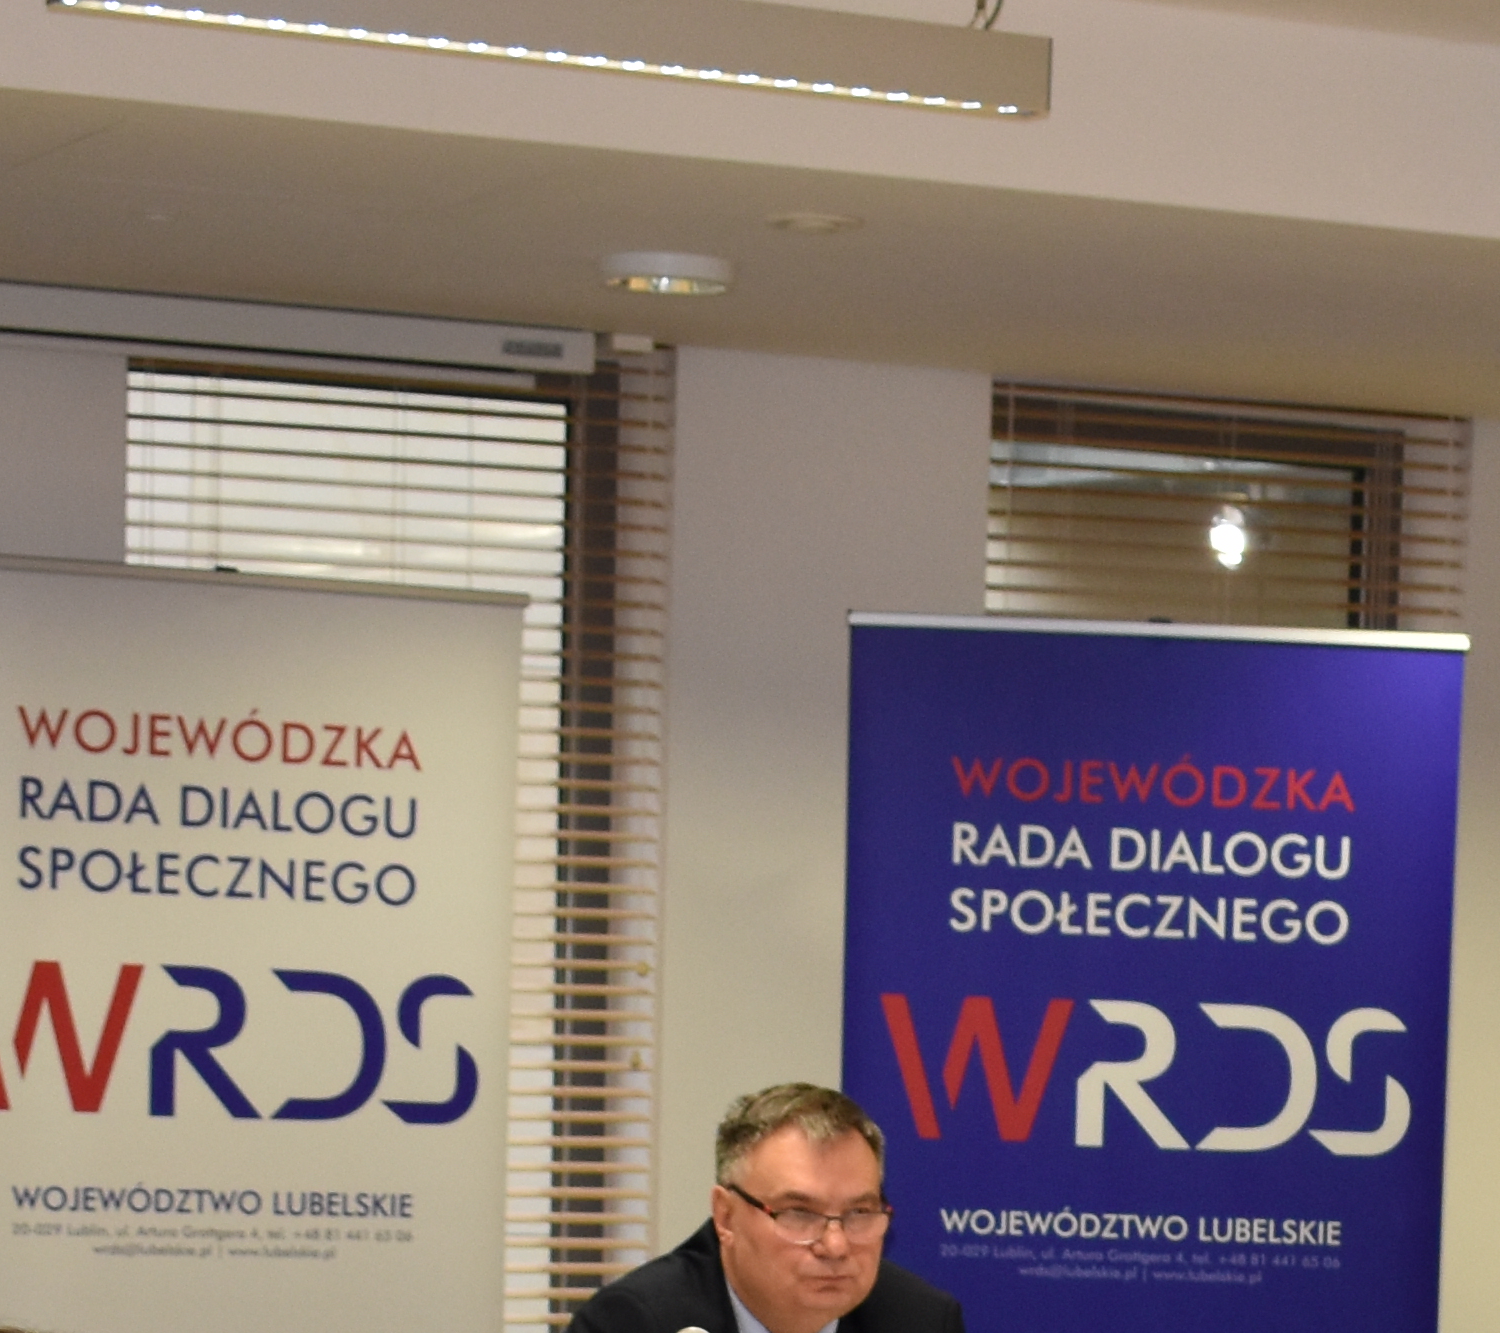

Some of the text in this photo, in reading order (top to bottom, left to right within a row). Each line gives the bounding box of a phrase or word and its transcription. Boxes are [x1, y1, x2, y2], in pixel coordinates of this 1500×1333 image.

[17, 705, 423, 772] WOJEWÓDZKA
[19, 776, 418, 839] RADA DIALOGU
[951, 754, 1355, 812] WOJEWÓDZKA
[17, 846, 417, 906] SPOŁECZNEGO
[952, 821, 1351, 879] RADA DIALOGU
[949, 887, 1349, 945] SPOŁECZNEGO
[880, 993, 1411, 1156] WRDS
[12, 1183, 414, 1219] WOJEWÓDZTWO LUBELSKIE
[940, 1206, 1342, 1246] WOJEWÓDZTWO LUBELSKIE
